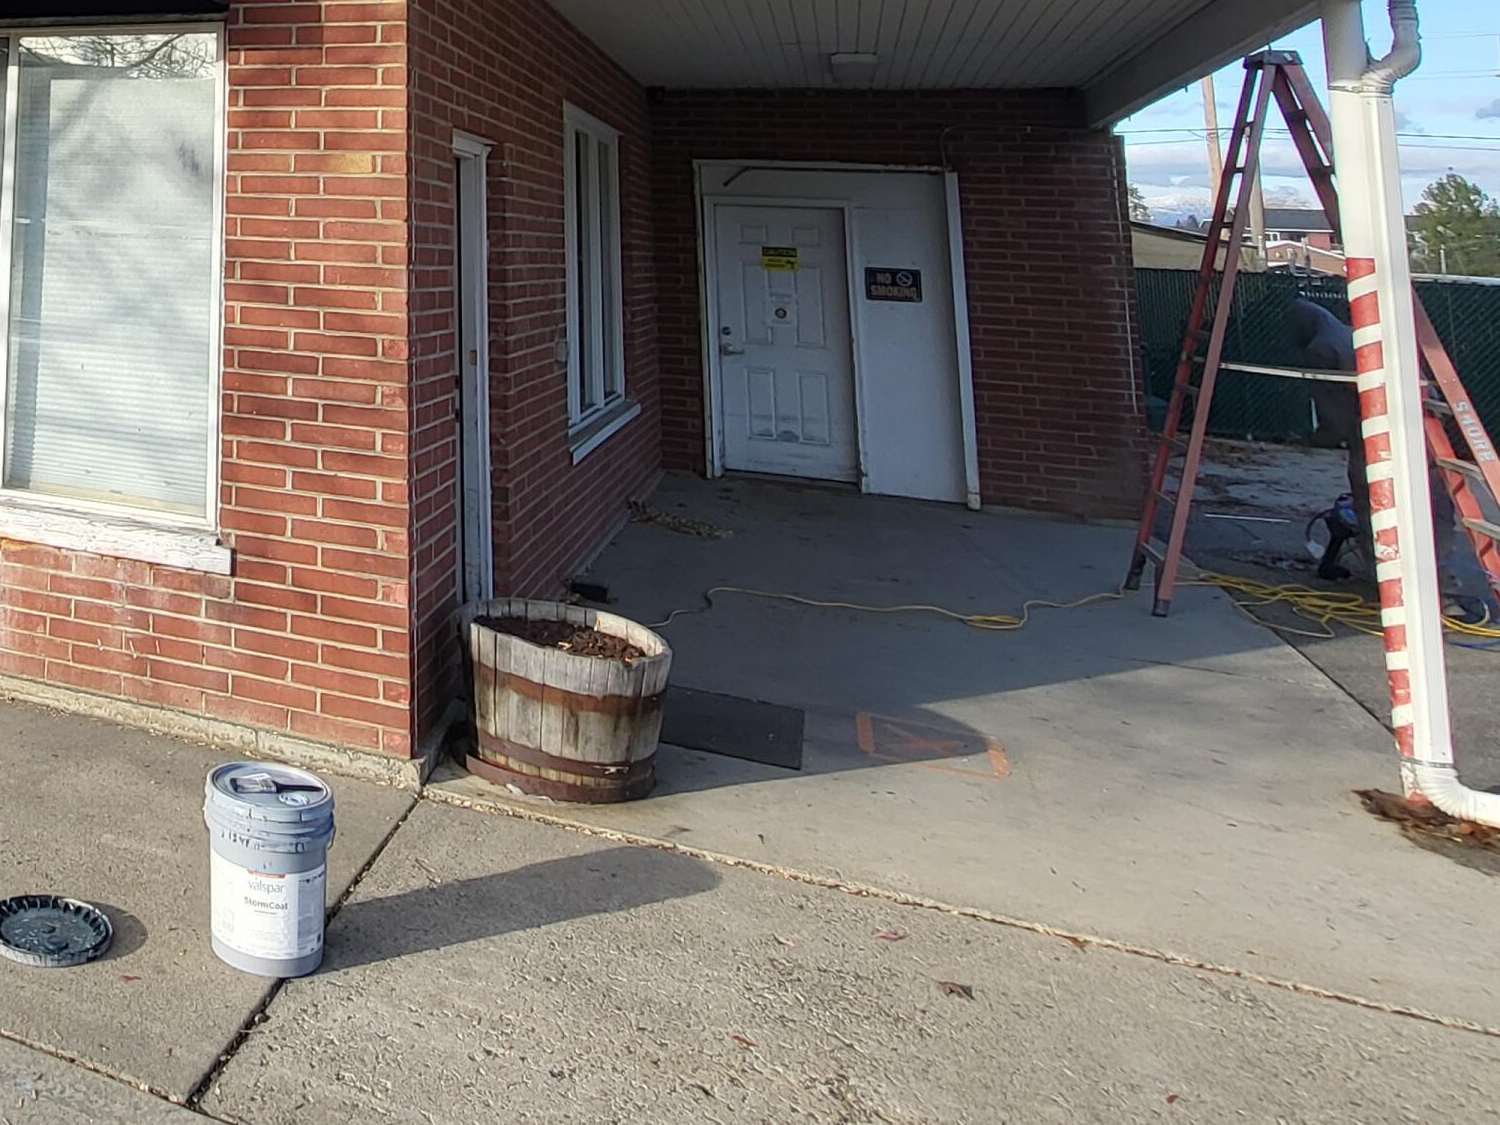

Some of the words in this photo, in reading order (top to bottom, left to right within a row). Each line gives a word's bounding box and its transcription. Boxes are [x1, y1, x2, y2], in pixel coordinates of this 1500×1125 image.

[876, 272, 892, 284] NO
[870, 285, 918, 300] SMOKING
[248, 879, 285, 894] valspar
[244, 896, 288, 910] StormCoat
